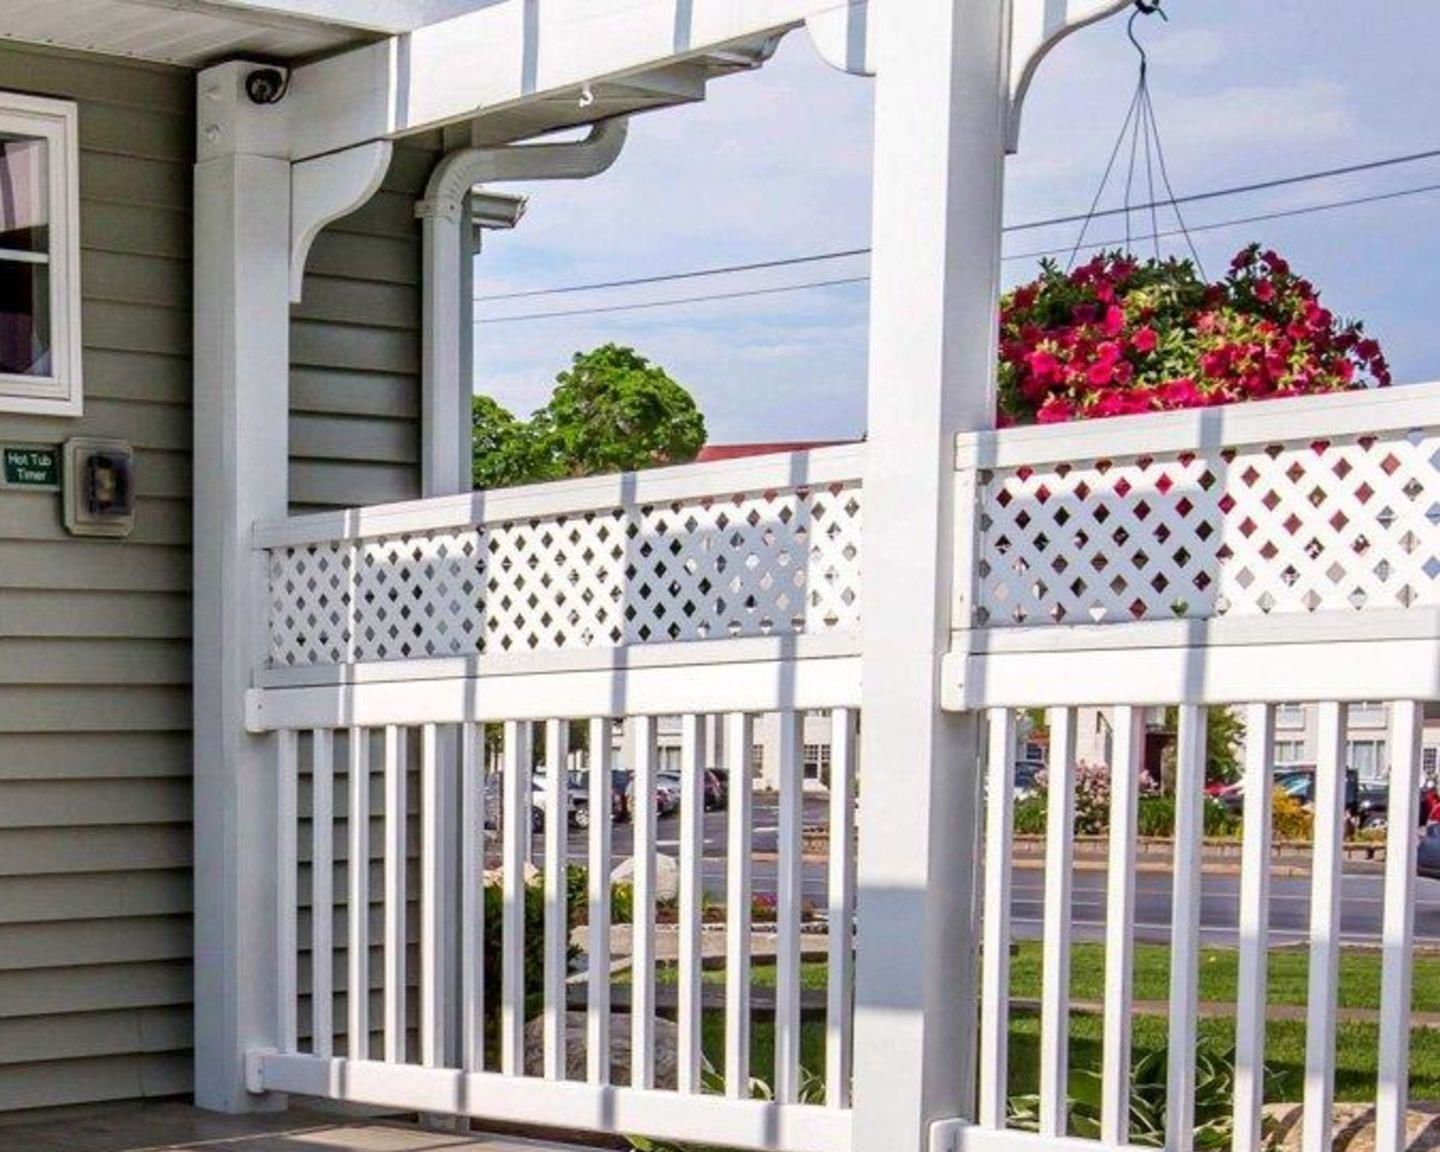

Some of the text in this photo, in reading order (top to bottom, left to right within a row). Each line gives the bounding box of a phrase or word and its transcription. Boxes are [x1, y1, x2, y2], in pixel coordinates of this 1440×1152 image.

[9, 453, 52, 467] Hot Tub
[17, 469, 47, 481] Timer
